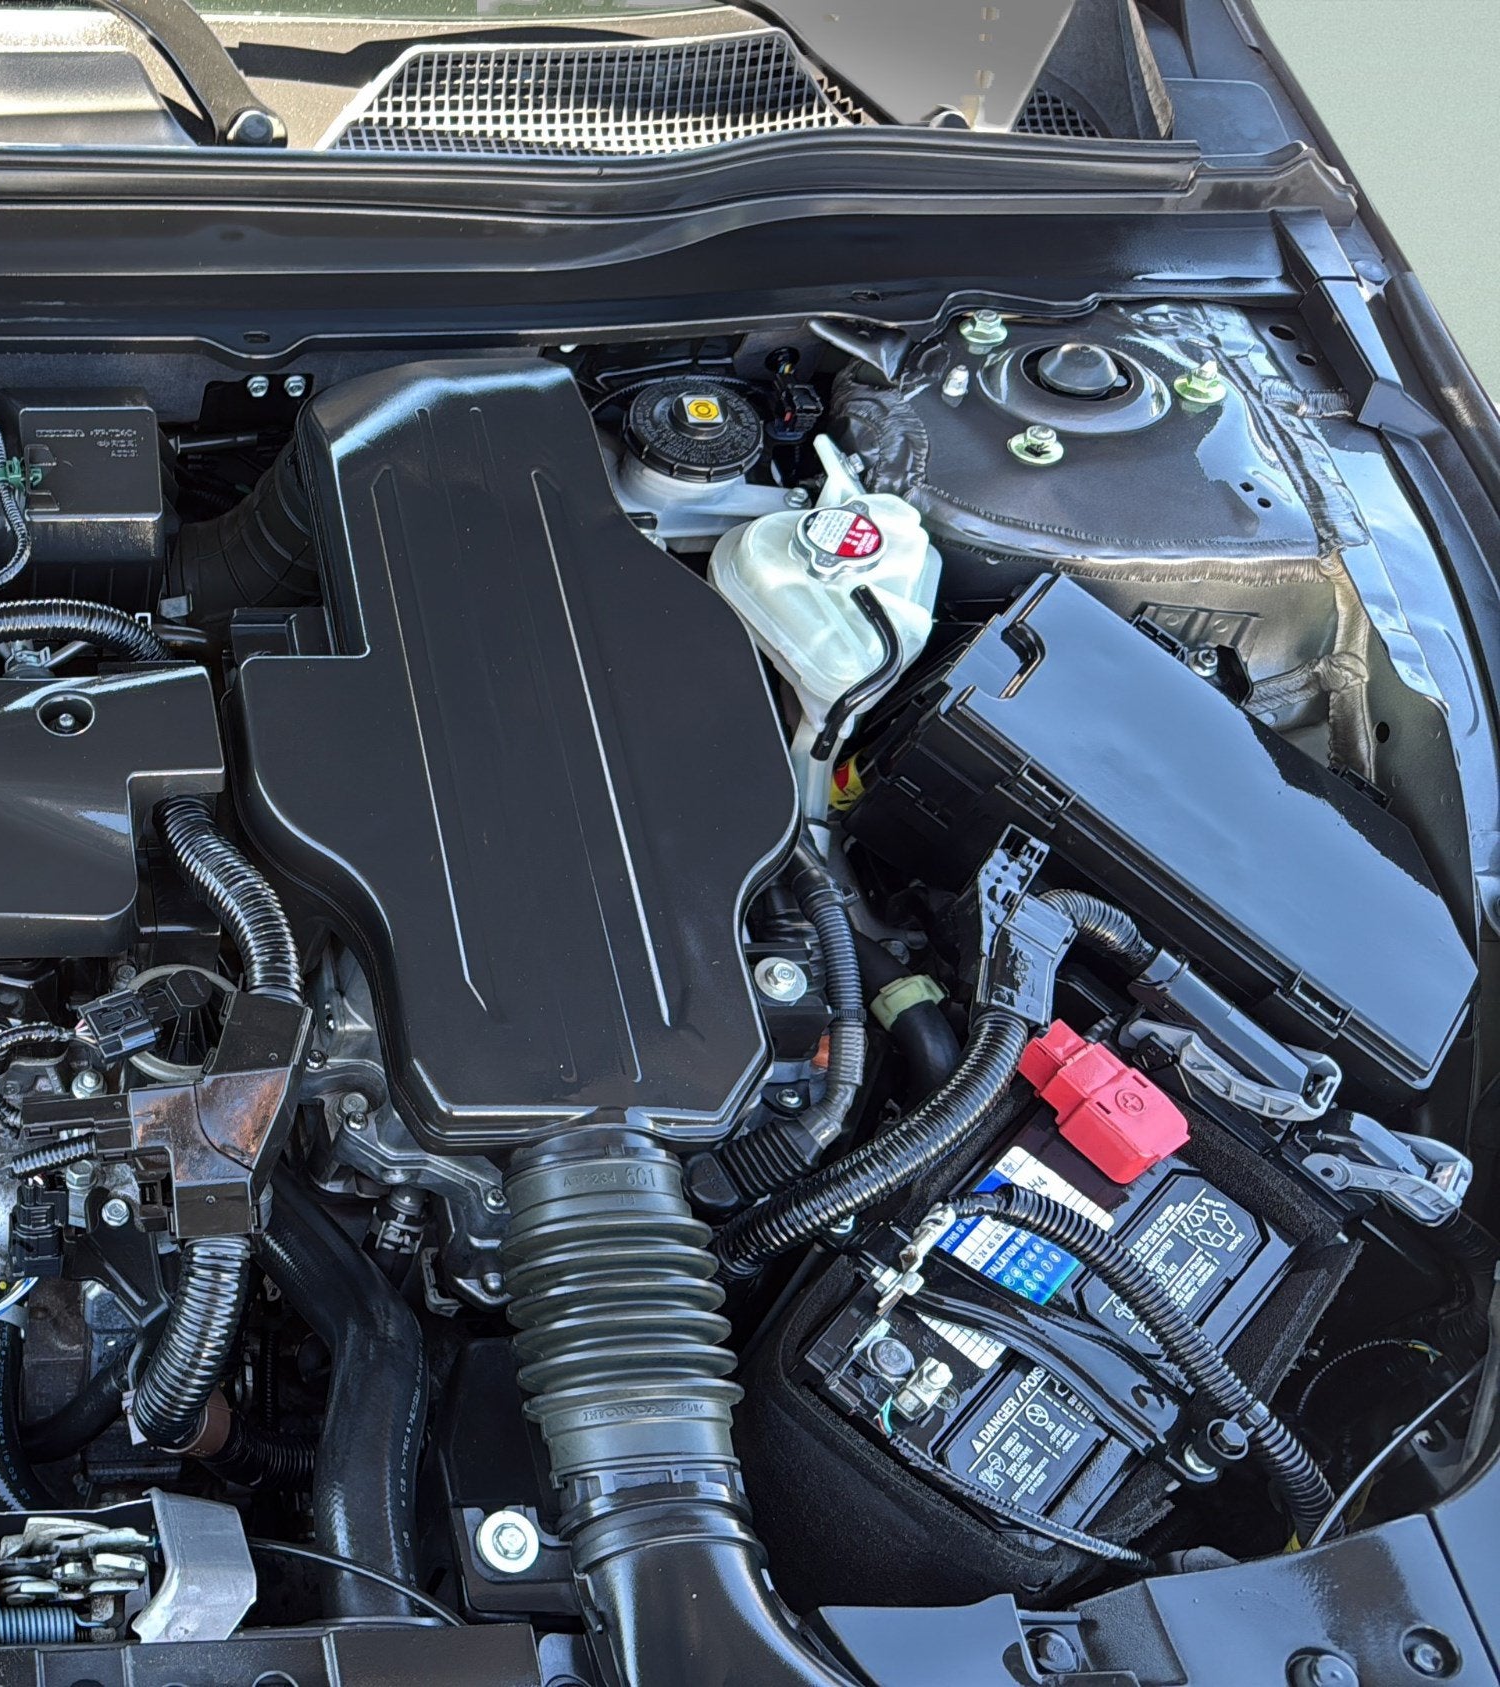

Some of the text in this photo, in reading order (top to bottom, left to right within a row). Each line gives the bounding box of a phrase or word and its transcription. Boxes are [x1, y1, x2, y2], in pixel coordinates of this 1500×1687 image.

[977, 1395, 1019, 1444] DANGER
[1018, 1363, 1047, 1394] POIS
[1000, 1430, 1020, 1453] SHIELD
[1007, 1441, 1024, 1459] EYES
[1004, 1444, 1034, 1478] EXPLOSIVE
[1012, 1461, 1032, 1483] GASES
